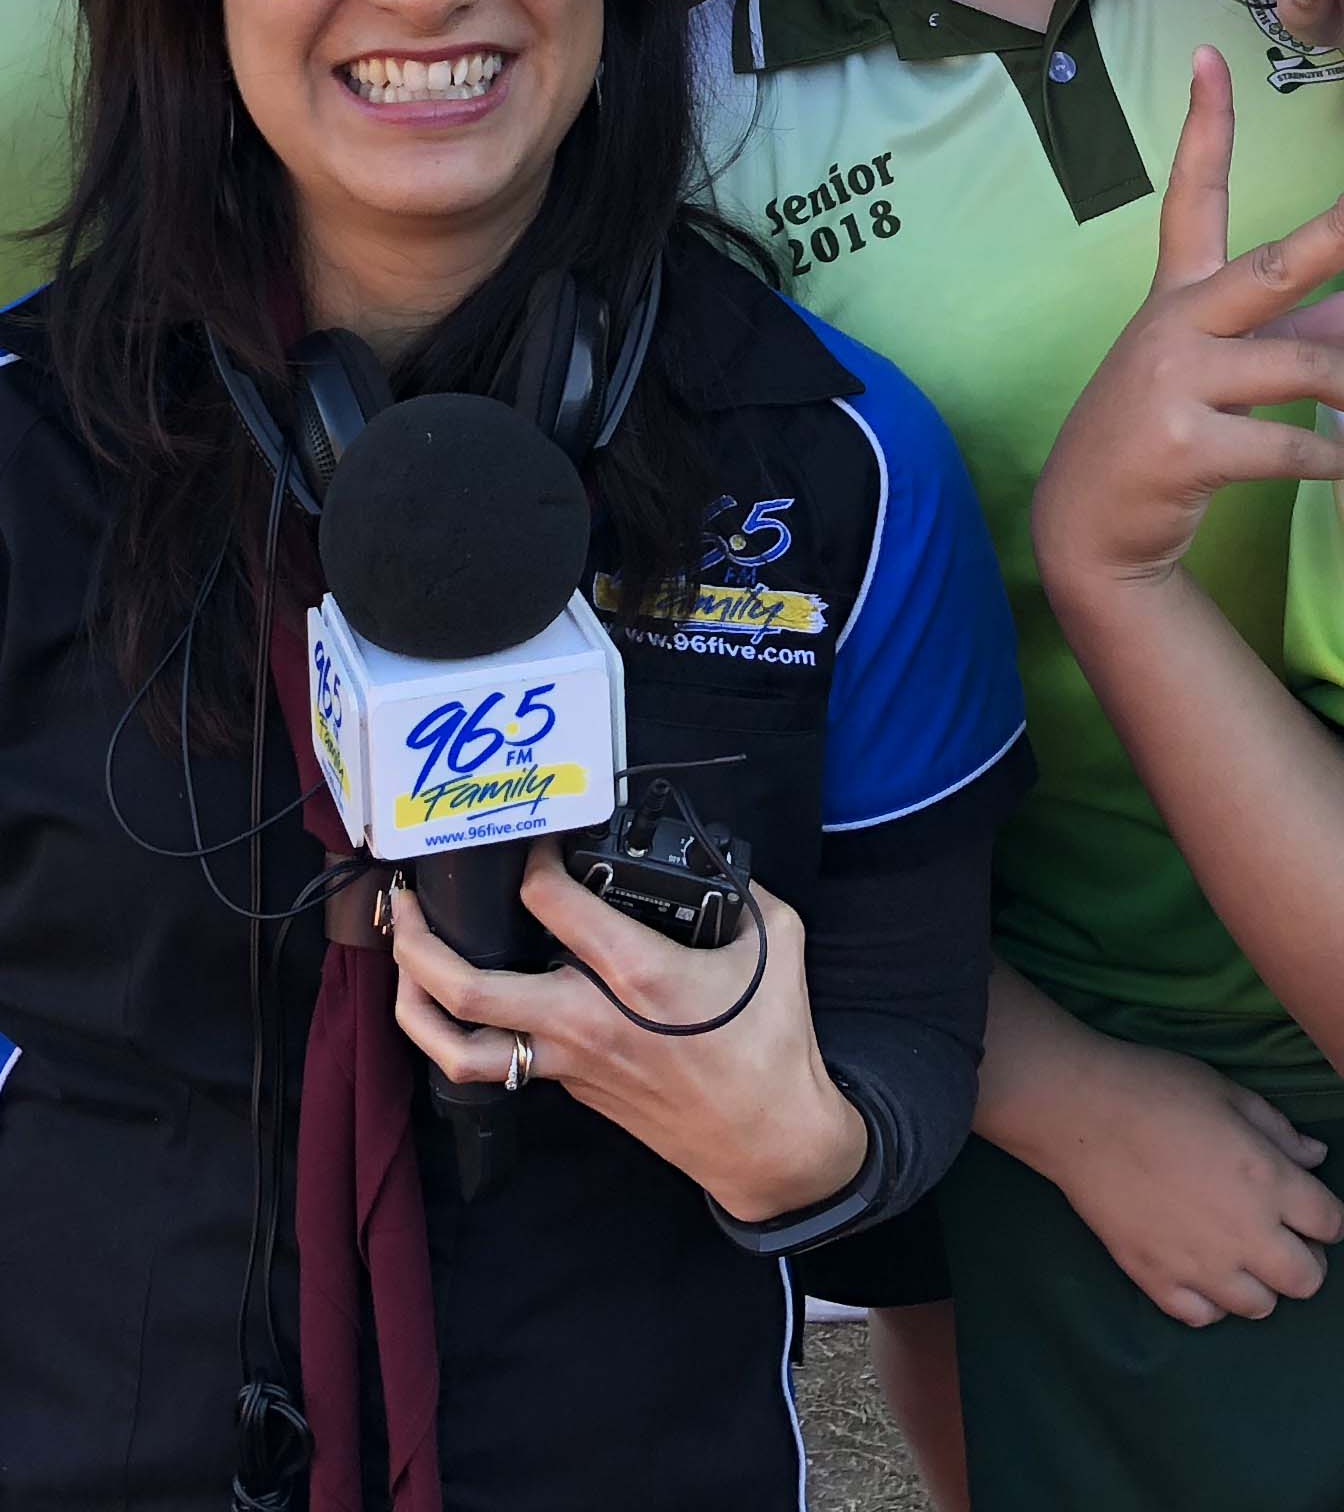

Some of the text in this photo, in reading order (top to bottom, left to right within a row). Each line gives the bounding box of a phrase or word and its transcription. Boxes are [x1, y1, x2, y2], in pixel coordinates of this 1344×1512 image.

[765, 151, 895, 237] Senior
[787, 199, 902, 277] 2018
[506, 747, 533, 767] FM
[421, 764, 556, 822] Family
[424, 816, 547, 847] www.96five.com
